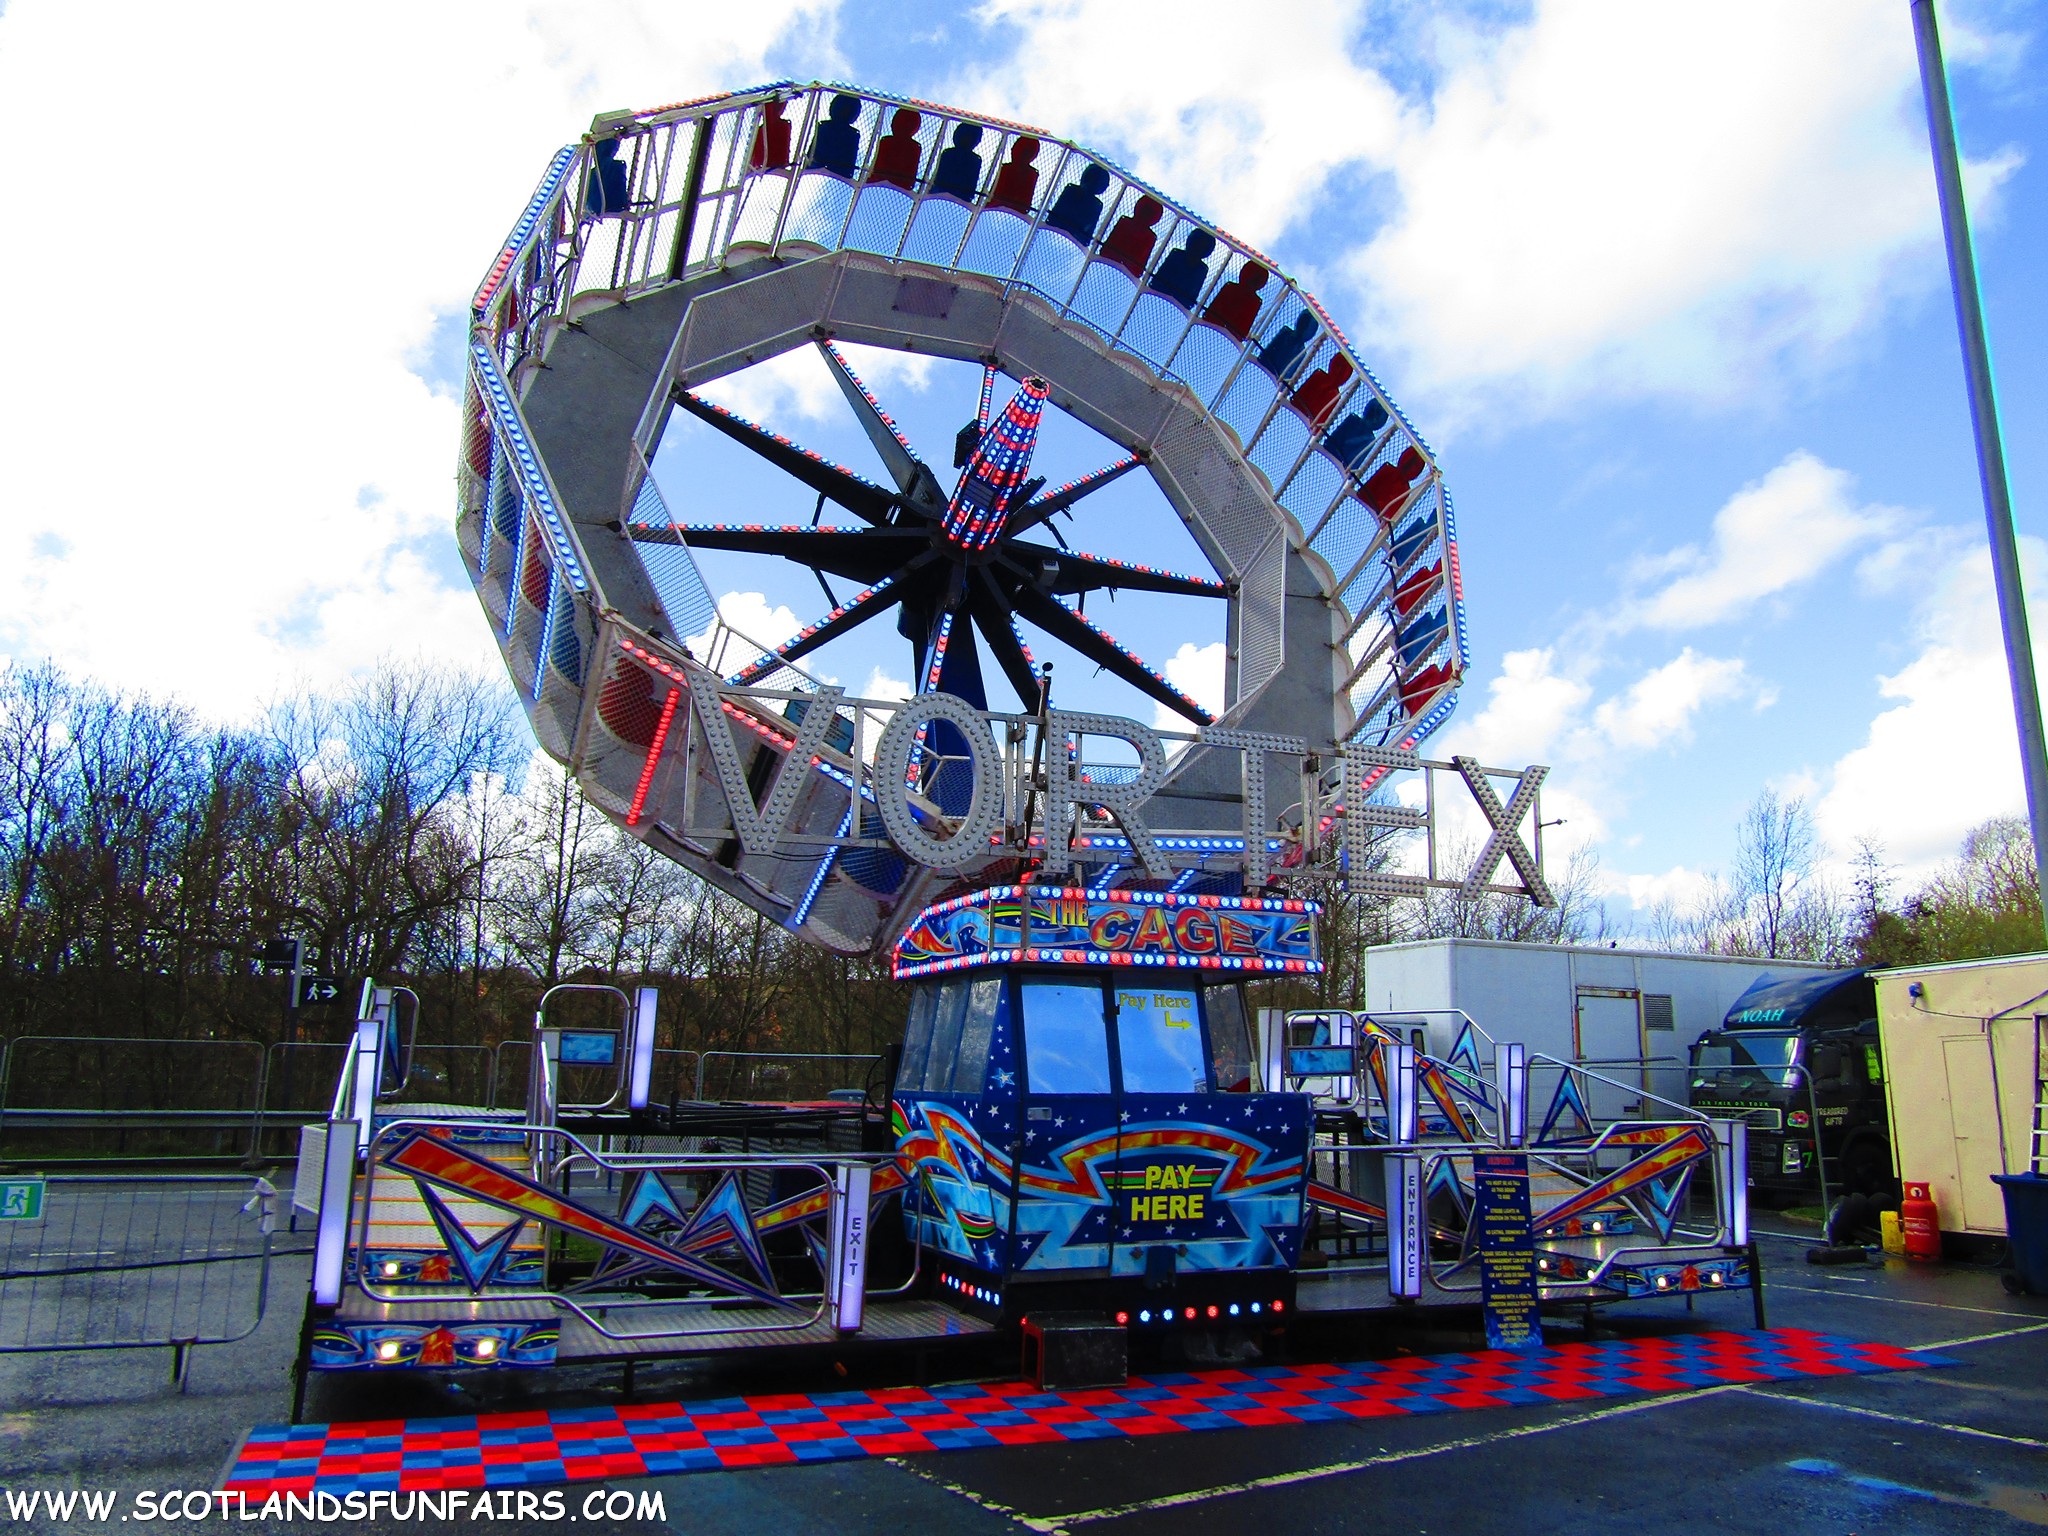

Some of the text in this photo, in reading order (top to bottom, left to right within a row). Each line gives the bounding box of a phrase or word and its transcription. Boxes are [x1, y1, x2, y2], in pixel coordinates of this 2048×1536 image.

[686, 670, 1554, 908] VORTEX
[1048, 899, 1258, 956] THE CAGE
[1118, 992, 1191, 1011] Pay Here
[1738, 1008, 1785, 1023] NOAH
[1145, 1164, 1197, 1190] PAY
[1131, 1194, 1204, 1222] HERE
[1406, 1174, 1416, 1279] ENTRANCE
[849, 1217, 861, 1276] EXIT
